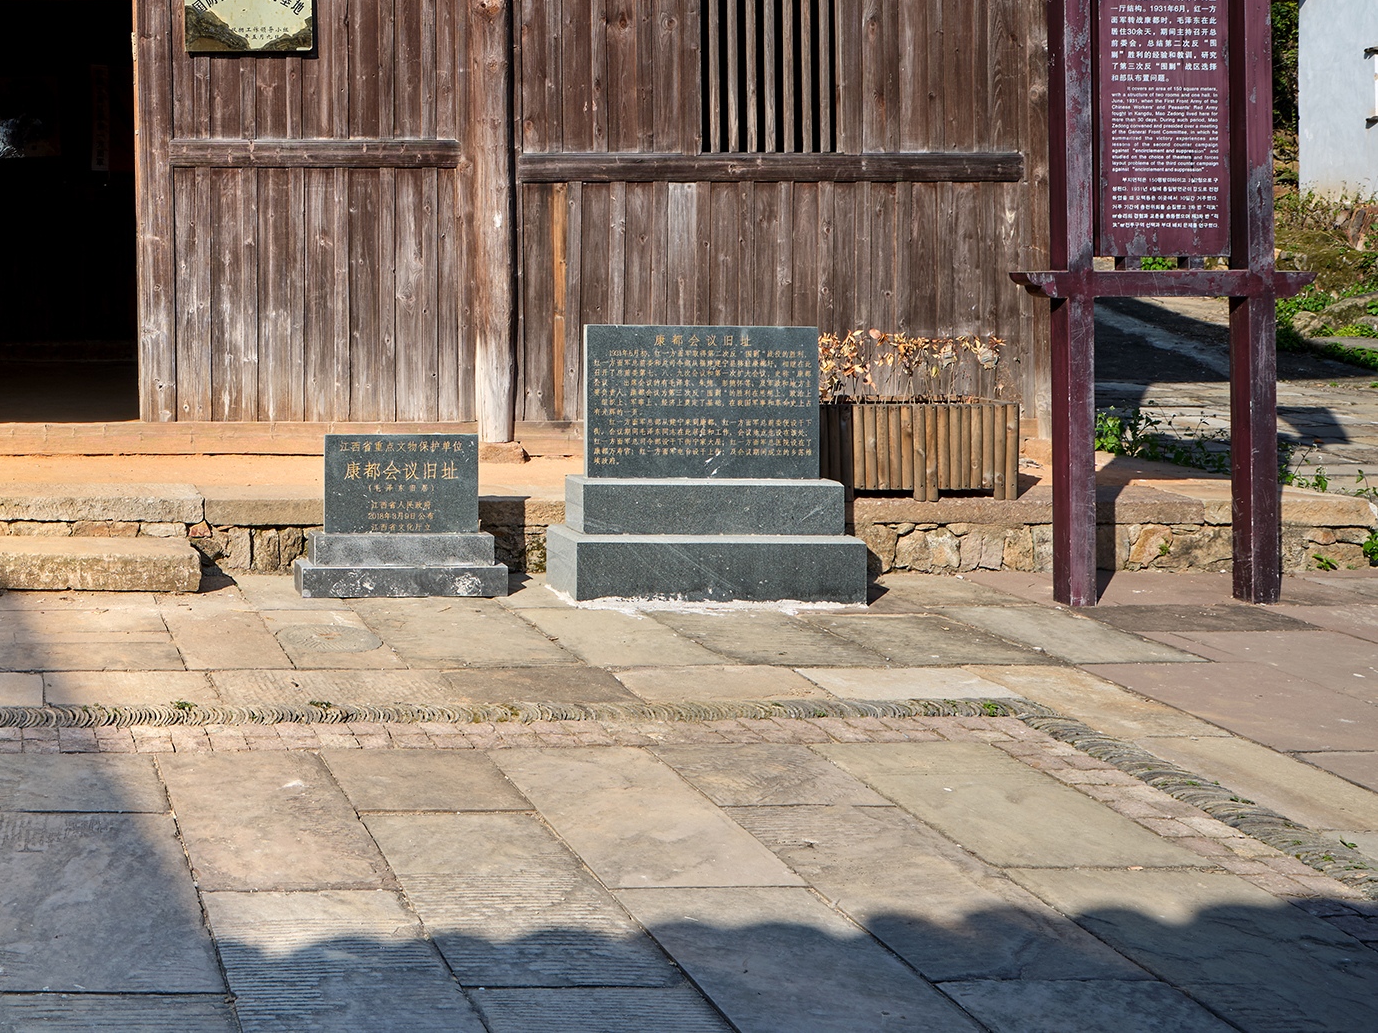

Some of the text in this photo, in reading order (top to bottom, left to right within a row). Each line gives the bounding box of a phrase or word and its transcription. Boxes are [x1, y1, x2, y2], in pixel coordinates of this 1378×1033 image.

[654, 334, 752, 347] 康都会议旧址
[339, 440, 464, 452] 江西省重点文物保护单位
[344, 460, 459, 481] 康都会议旧址
[370, 501, 432, 509] 江西省人民政府
[368, 512, 434, 520] 2018年3月9日公布
[370, 523, 432, 531] 江西省文化厅立
